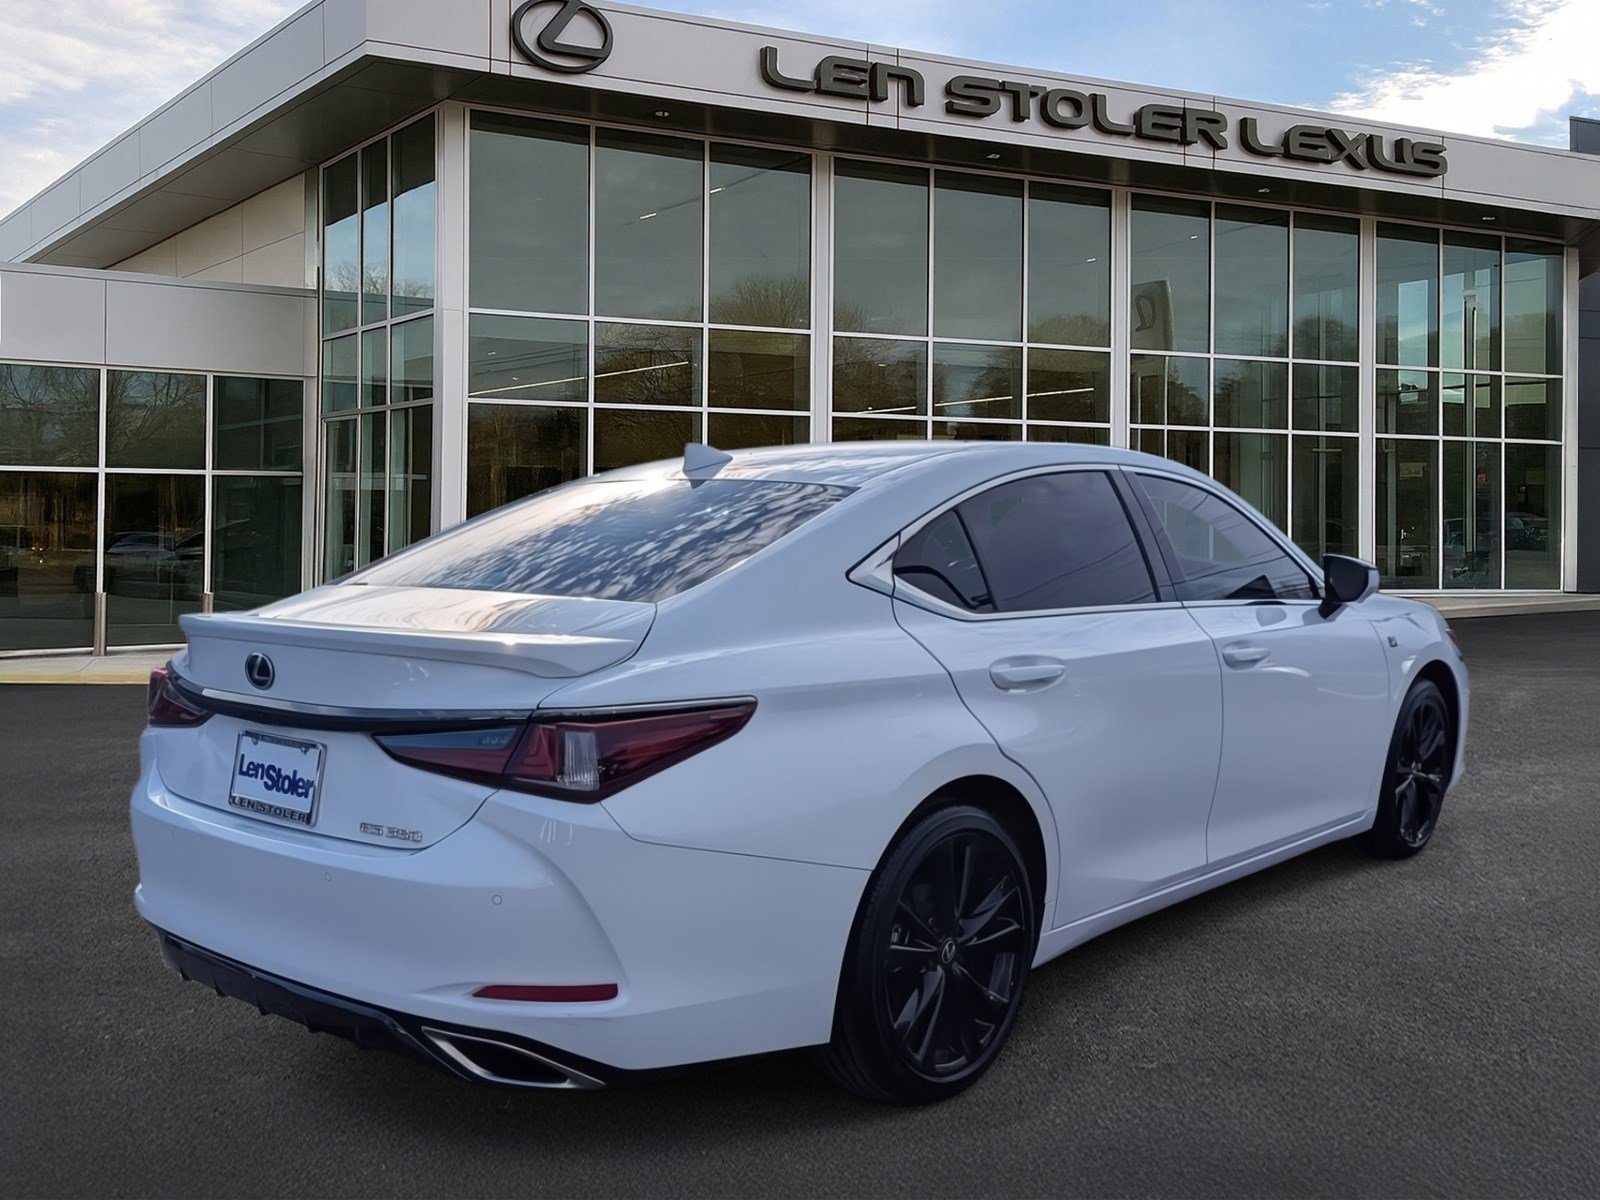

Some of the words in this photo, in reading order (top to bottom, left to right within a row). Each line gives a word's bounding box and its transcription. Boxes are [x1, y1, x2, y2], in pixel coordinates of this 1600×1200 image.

[760, 46, 924, 107] LEN
[945, 76, 1227, 149] STOLER
[1240, 117, 1448, 177] LEXUS
